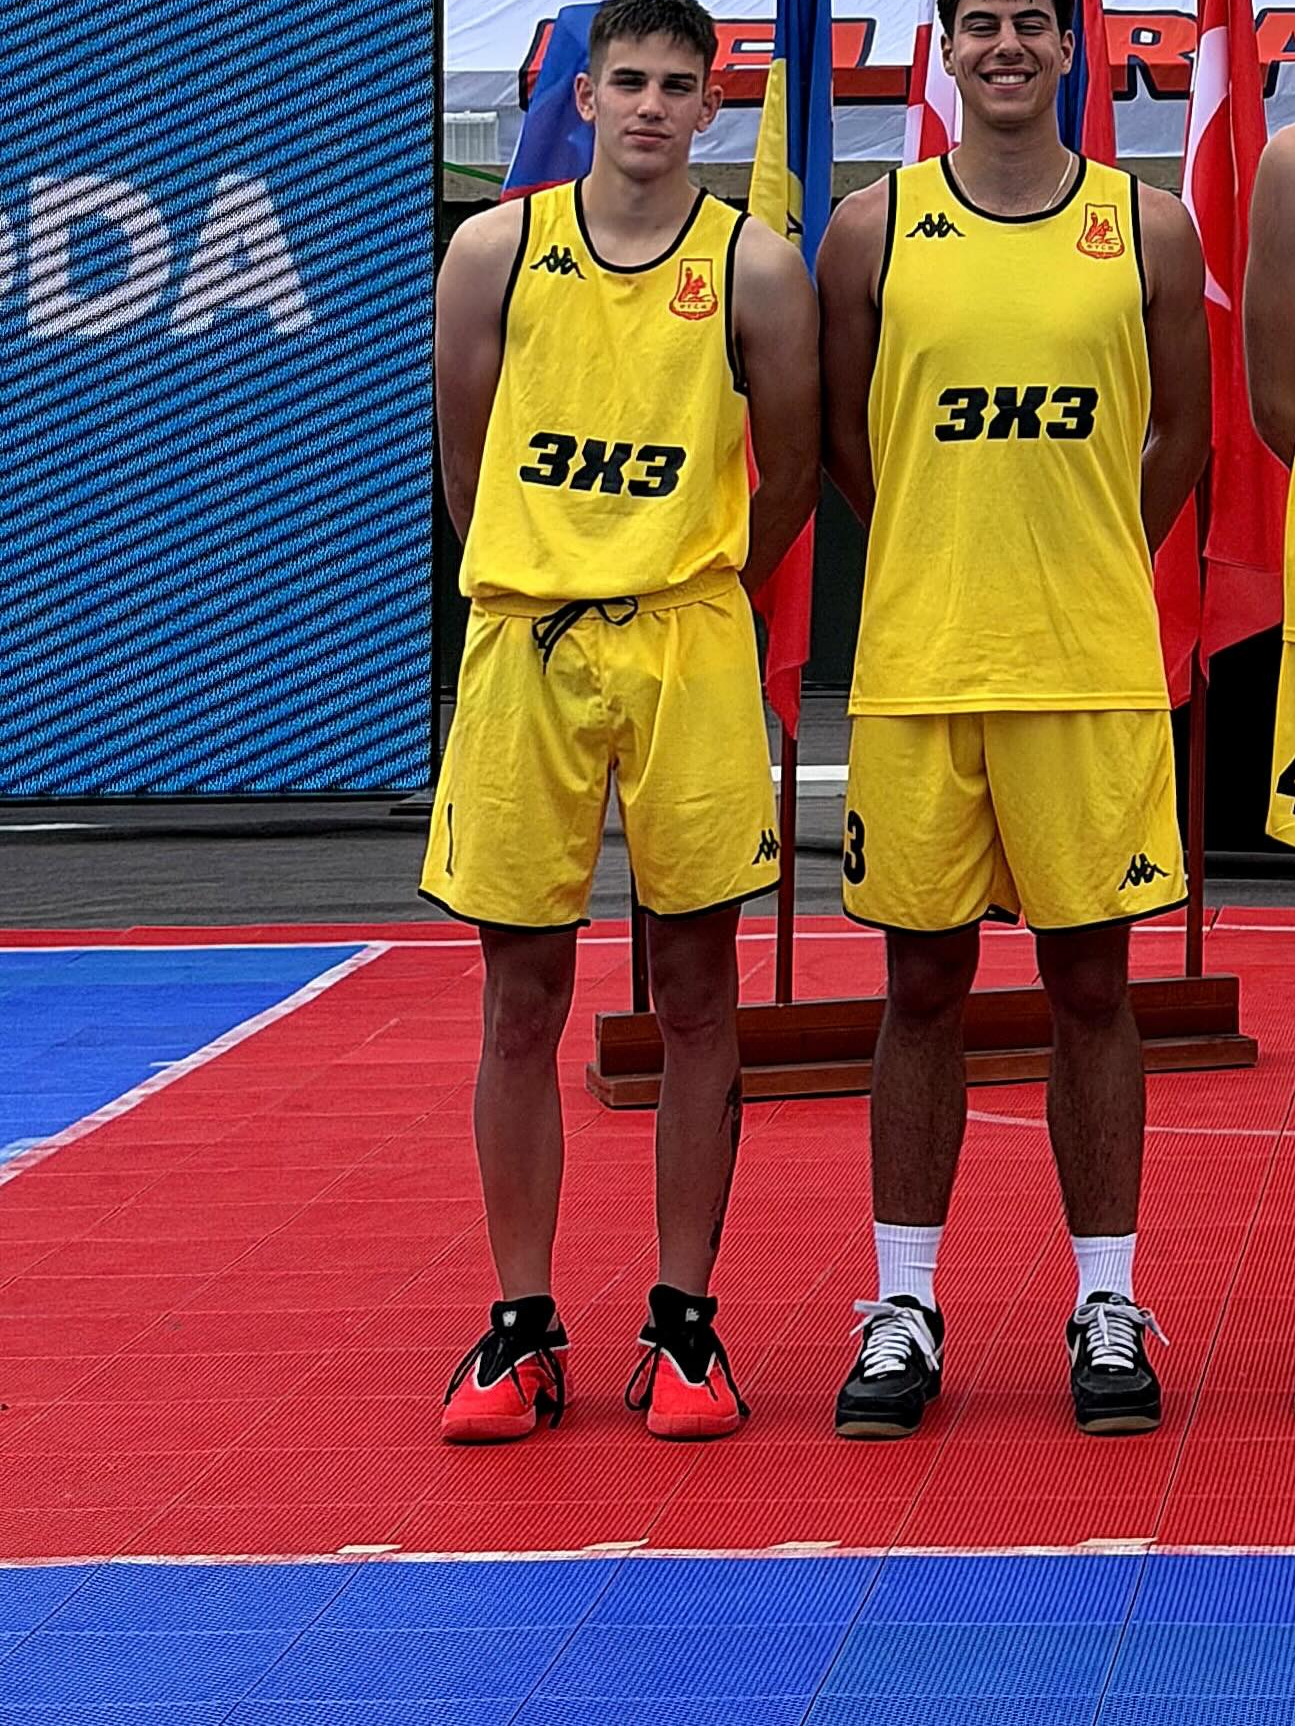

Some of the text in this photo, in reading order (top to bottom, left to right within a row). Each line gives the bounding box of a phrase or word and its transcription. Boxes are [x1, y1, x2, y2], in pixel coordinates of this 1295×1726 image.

[0, 173, 314, 337] DA
[934, 386, 1100, 442] 3X3
[519, 430, 687, 498] 3X3
[842, 809, 867, 885] 3
